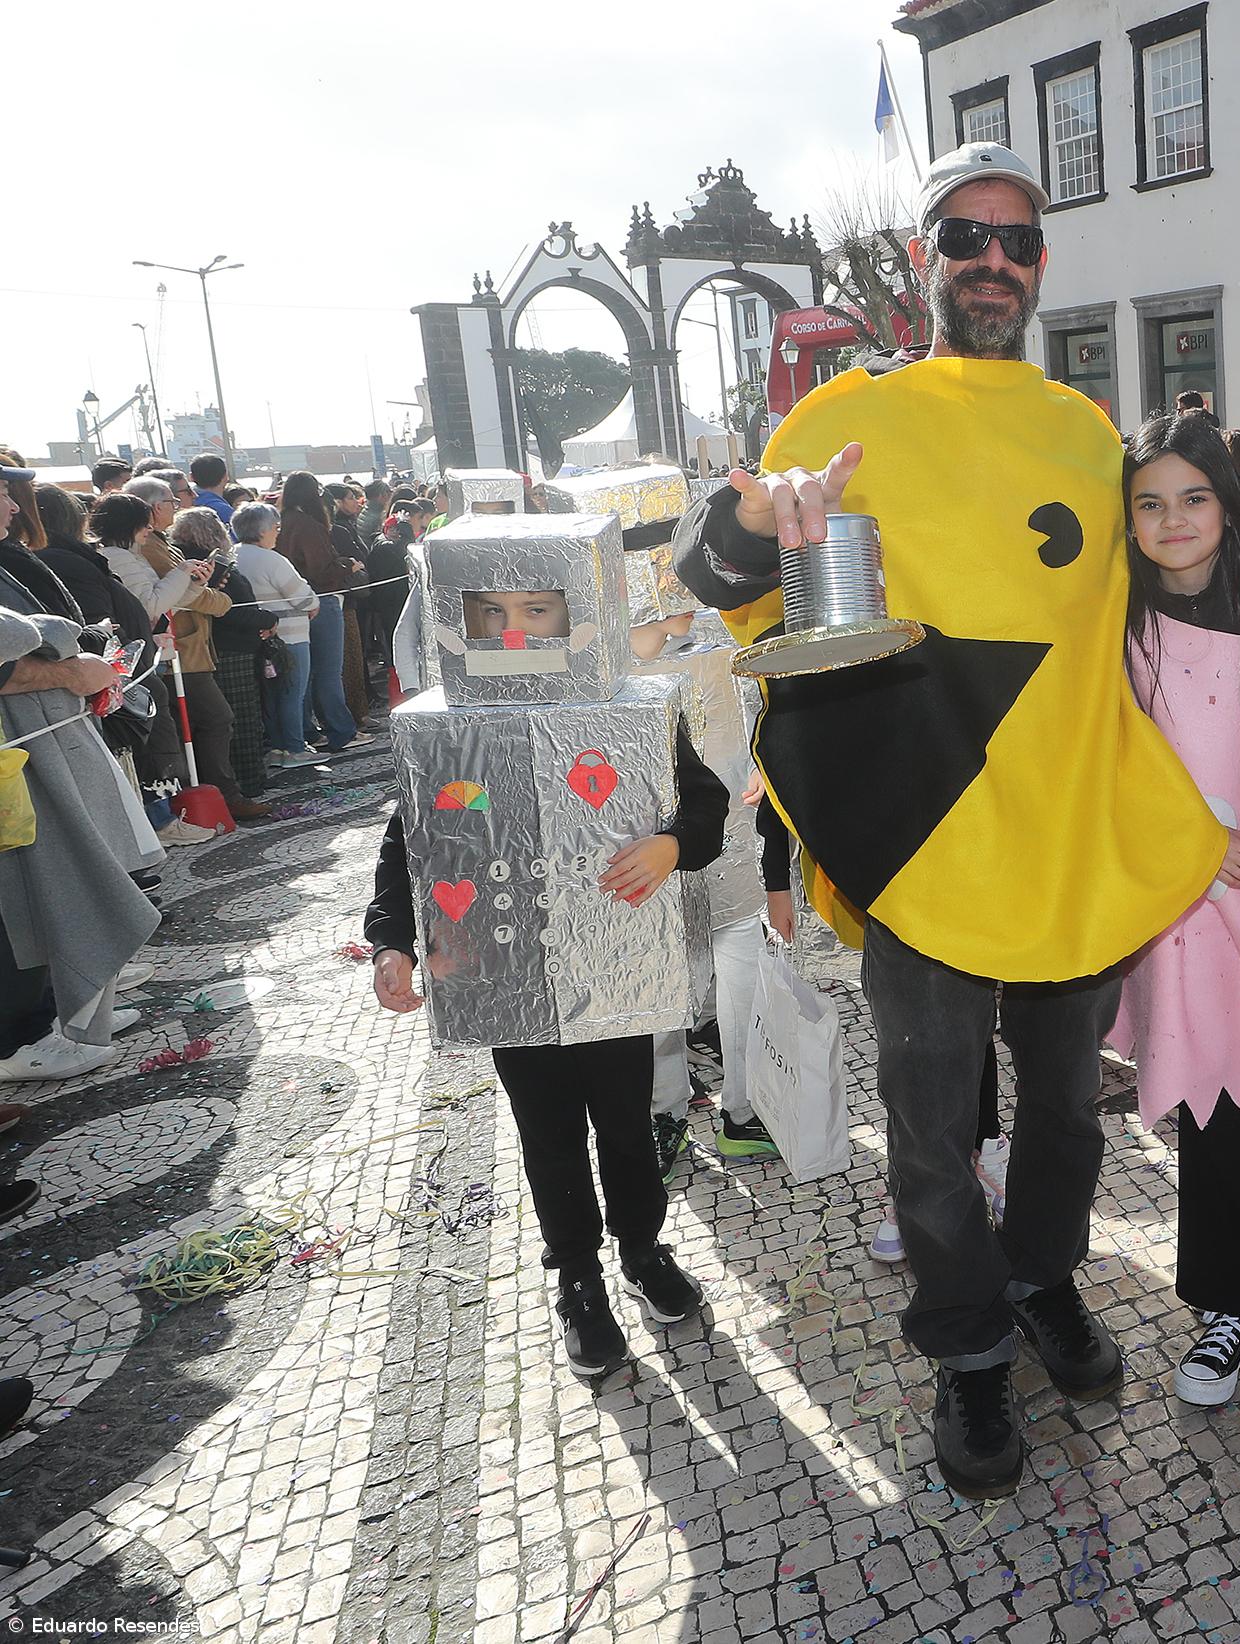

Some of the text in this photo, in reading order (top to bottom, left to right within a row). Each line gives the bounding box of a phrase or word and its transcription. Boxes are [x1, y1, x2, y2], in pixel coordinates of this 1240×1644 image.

[791, 322, 816, 334] CORSO
[817, 321, 826, 331] DE
[1190, 334, 1208, 350] BPI
[1090, 346, 1106, 361] BPI
[495, 855, 587, 877] 1 2 3
[498, 893, 593, 909] 4 5 6
[497, 924, 597, 944] 7 8 9
